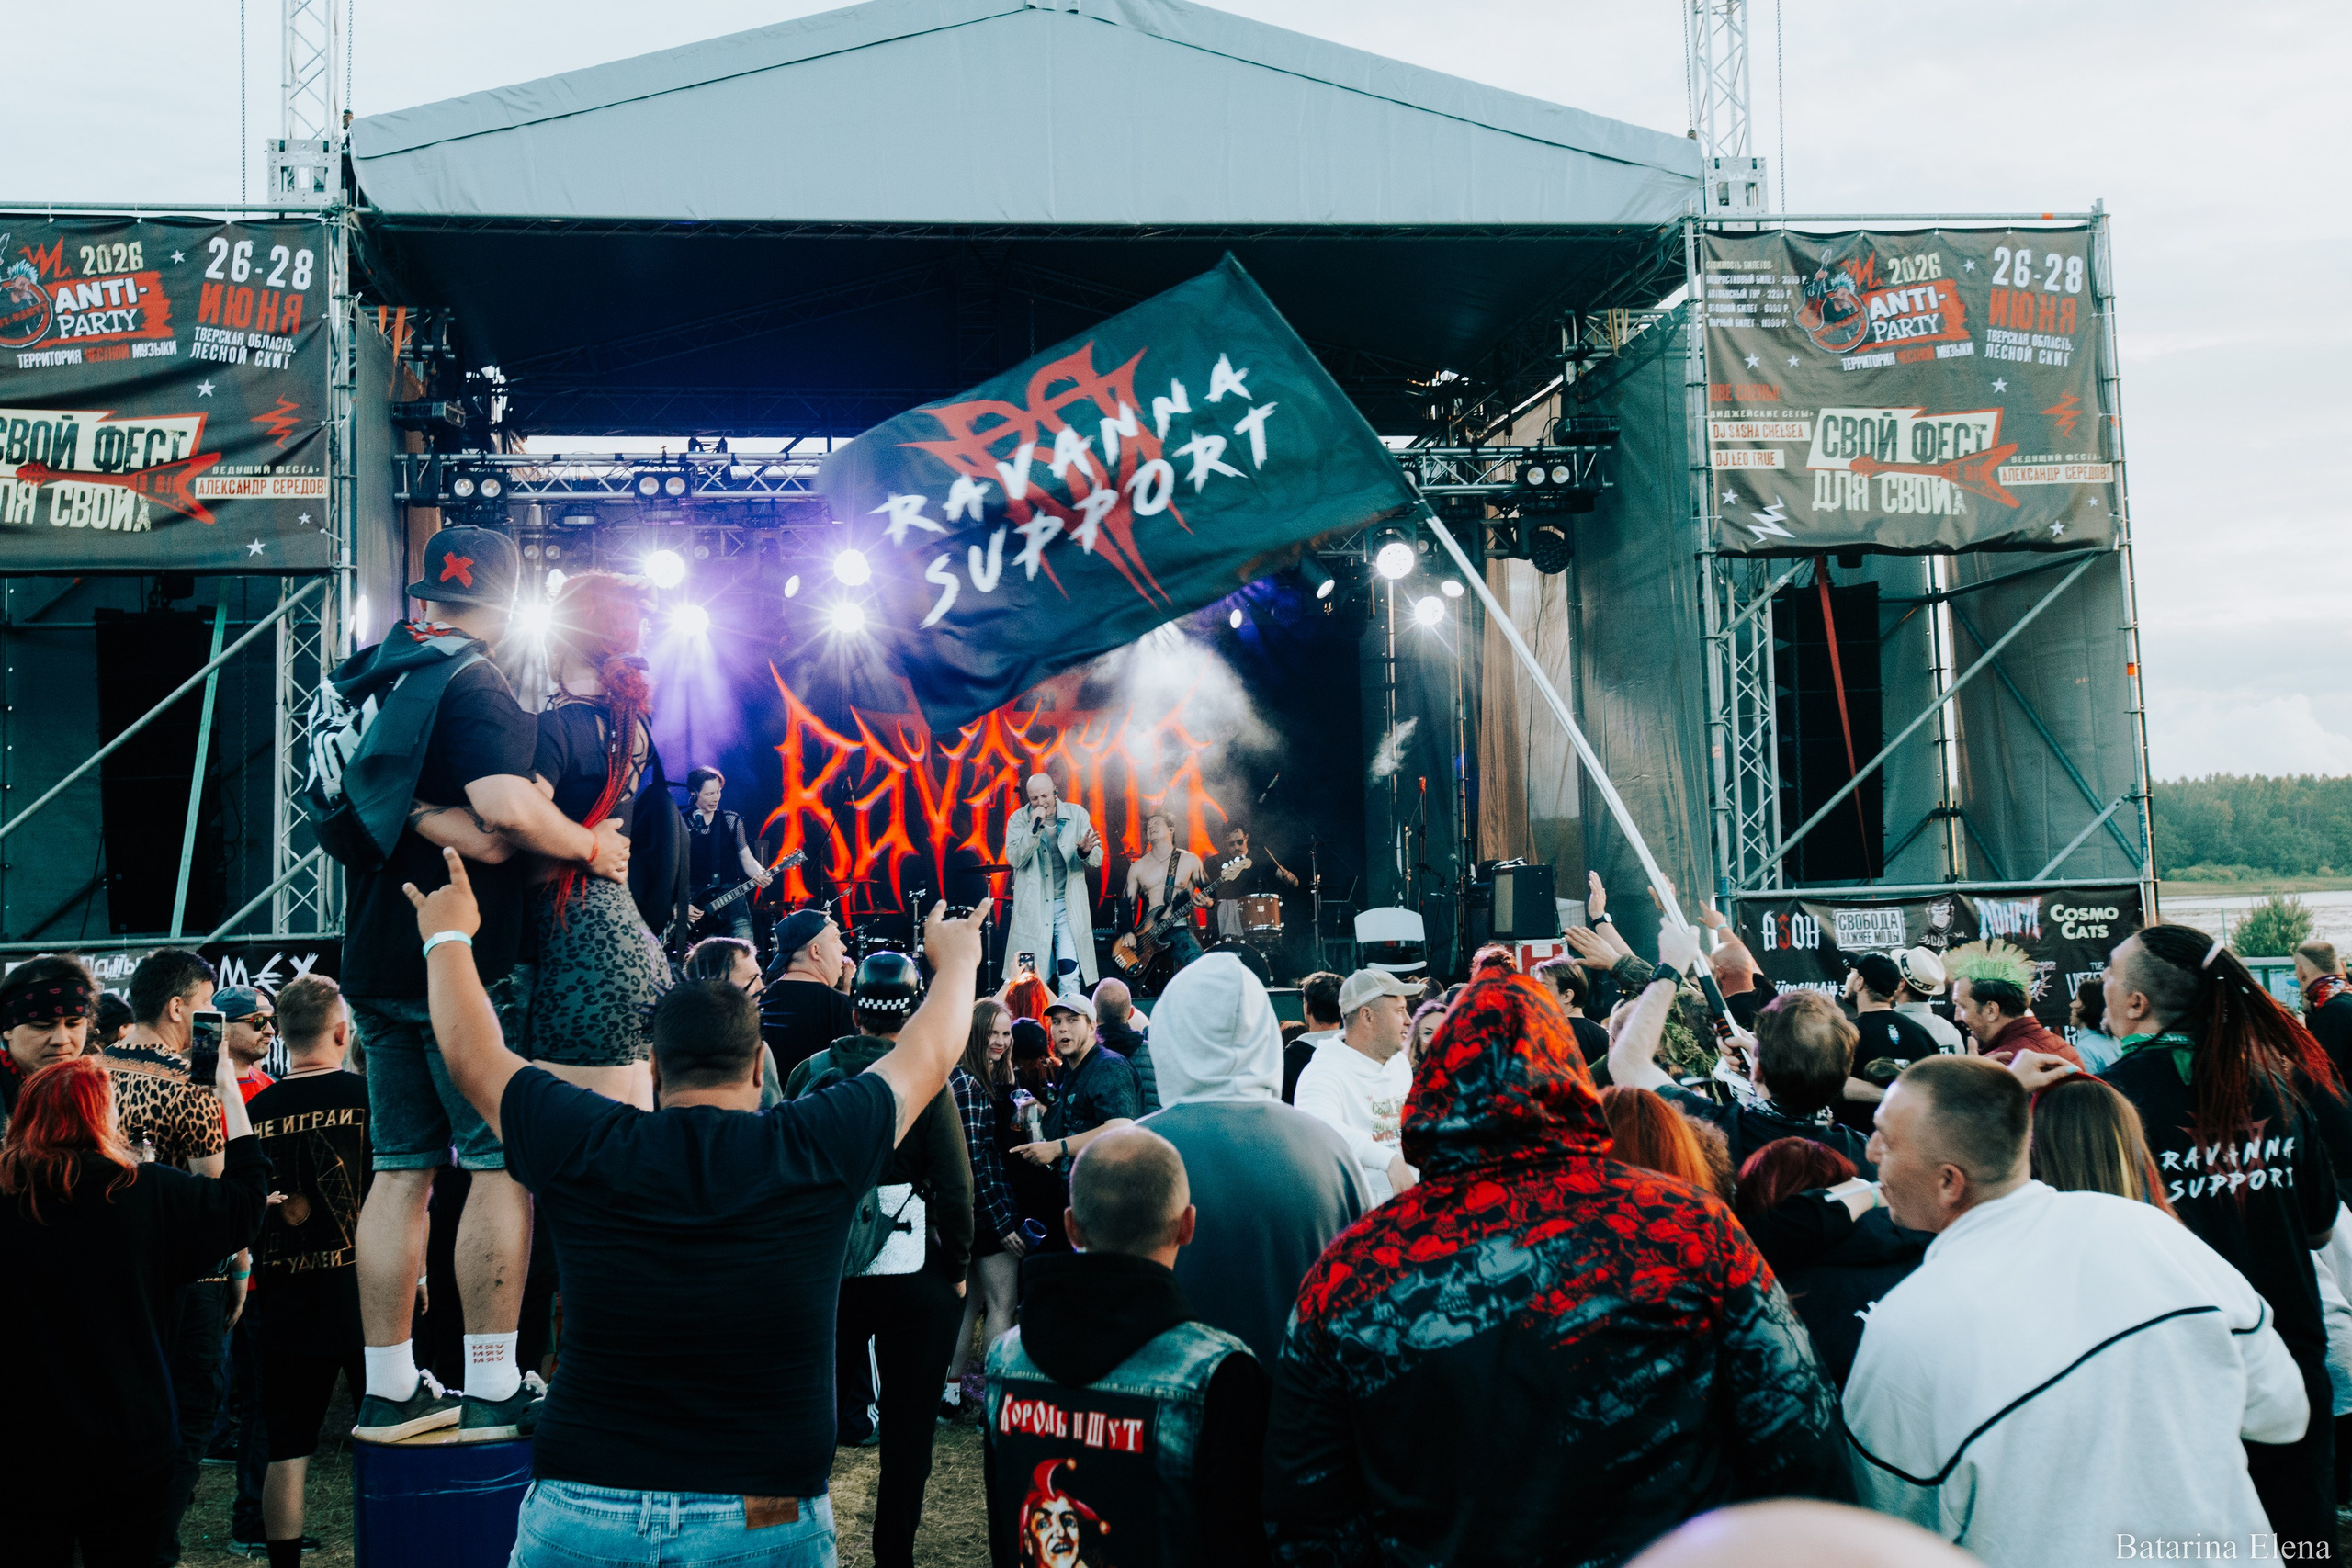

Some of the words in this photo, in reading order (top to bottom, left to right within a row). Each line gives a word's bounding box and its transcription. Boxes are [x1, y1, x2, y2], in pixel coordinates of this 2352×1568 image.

[80, 241, 144, 276] 2026
[205, 237, 314, 290] 26-28
[1888, 252, 1942, 285] 2026
[1992, 246, 2083, 294] 26-28
[55, 277, 149, 314] ANTI-
[198, 282, 304, 335] ИЮНЯ
[1870, 286, 1947, 320] ANTI-
[57, 308, 138, 340] PARTY
[1988, 288, 2076, 335] ИЮНЯ
[194, 326, 245, 346] ТВЕРСКАЯ
[1871, 313, 1939, 344] PARTY
[1986, 329, 2030, 346] ТВЕРСКАЯ
[17, 349, 83, 368] ТЕРРИТОРИЯ
[84, 343, 130, 364] ЧЕСТНОЙ
[131, 340, 177, 359] МУЗЫКИ
[189, 342, 248, 365] ЛЕСНОЙ
[254, 350, 292, 369] СКИТ
[1840, 352, 1896, 371] ТЕРРИТОРИЯ
[1936, 342, 1974, 359] МУЗЫКИ
[1984, 343, 2033, 363] ЛЕСНОЙ
[2038, 349, 2071, 367] СКИТ
[1710, 383, 1733, 401] ДВЕ
[1709, 409, 1779, 419] ДИДЖЕЙСКИЕ
[1713, 424, 1726, 438] DJ
[1728, 424, 1759, 438] SASHA
[1762, 424, 1804, 438] CHELSEA
[1822, 412, 1898, 462] СВОЙ
[1911, 421, 1987, 465] ФЕСТ
[92, 425, 187, 474] ФЕСТ
[866, 352, 1253, 547] RAVANNA
[1715, 452, 1728, 466] DJ
[1732, 452, 1749, 466] LEO
[1752, 451, 1776, 466] TRUE
[2011, 453, 2063, 463] ВЕДУЩИЙ
[211, 464, 271, 475] ВЕДУЩИЙ
[2002, 467, 2061, 482] АЛЕКСАНДР
[198, 479, 267, 496] АЛЕКСАНДР
[272, 479, 327, 495] СЕРЕДОВ!
[1812, 469, 1870, 513] ДЛЯ
[1882, 476, 1967, 515] СВОИХ
[50, 484, 151, 532] СВОИХ
[920, 401, 1278, 630] SUPPORT
[1838, 912, 1899, 931] СВОБОДА
[1840, 931, 1871, 944] ВАЖНЕЕ
[1874, 930, 1901, 944] МОДЫ
[283, 1108, 353, 1134] ИГРАЙ
[2160, 1135, 2295, 1172] RAVANNA
